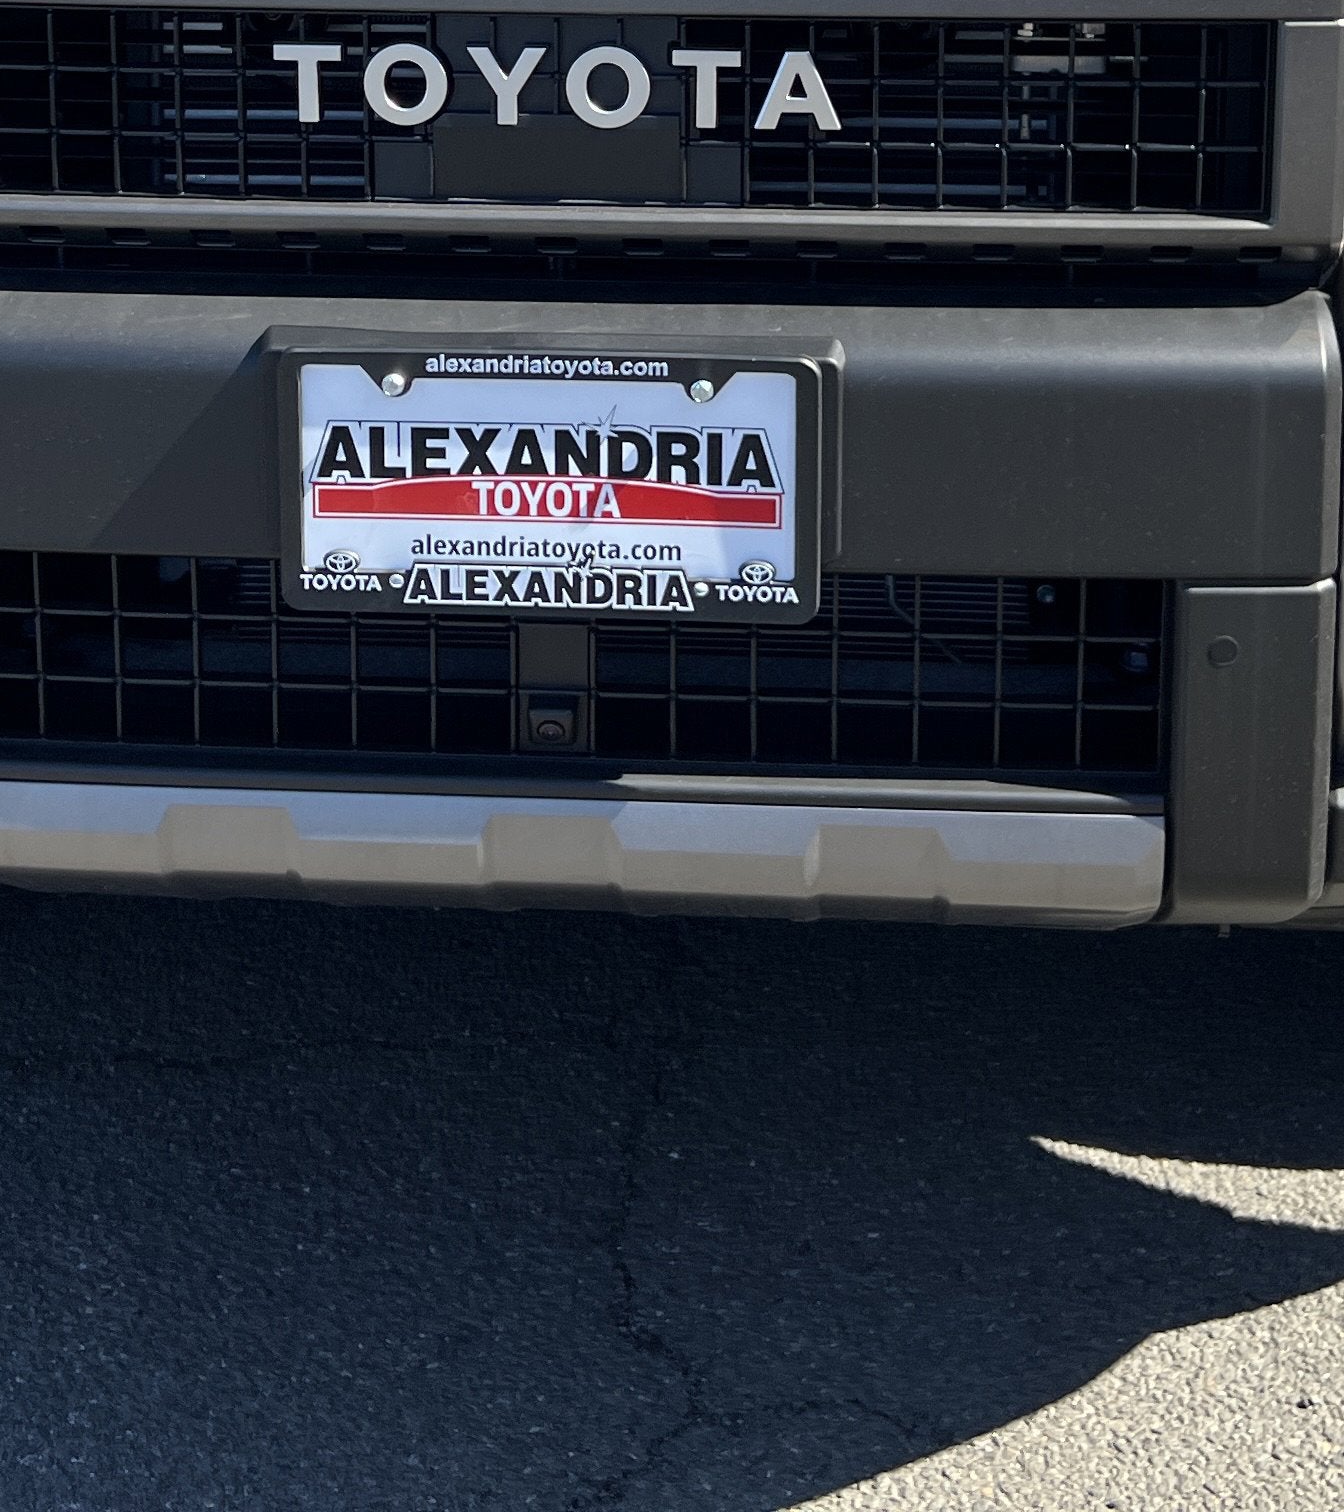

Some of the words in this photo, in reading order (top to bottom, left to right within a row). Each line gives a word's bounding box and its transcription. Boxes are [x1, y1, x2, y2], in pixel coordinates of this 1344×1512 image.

[272, 43, 842, 130] TOYOTA
[425, 354, 669, 378] alexandriatoyota.com
[315, 423, 779, 490] ALEXANDRIA
[471, 480, 622, 519] TOYOTA
[410, 534, 682, 562] alexandriatoyota.com
[300, 573, 382, 592] TOYOTA
[403, 562, 695, 612] ALEXANDRIA
[715, 583, 799, 604] TOYOTA
